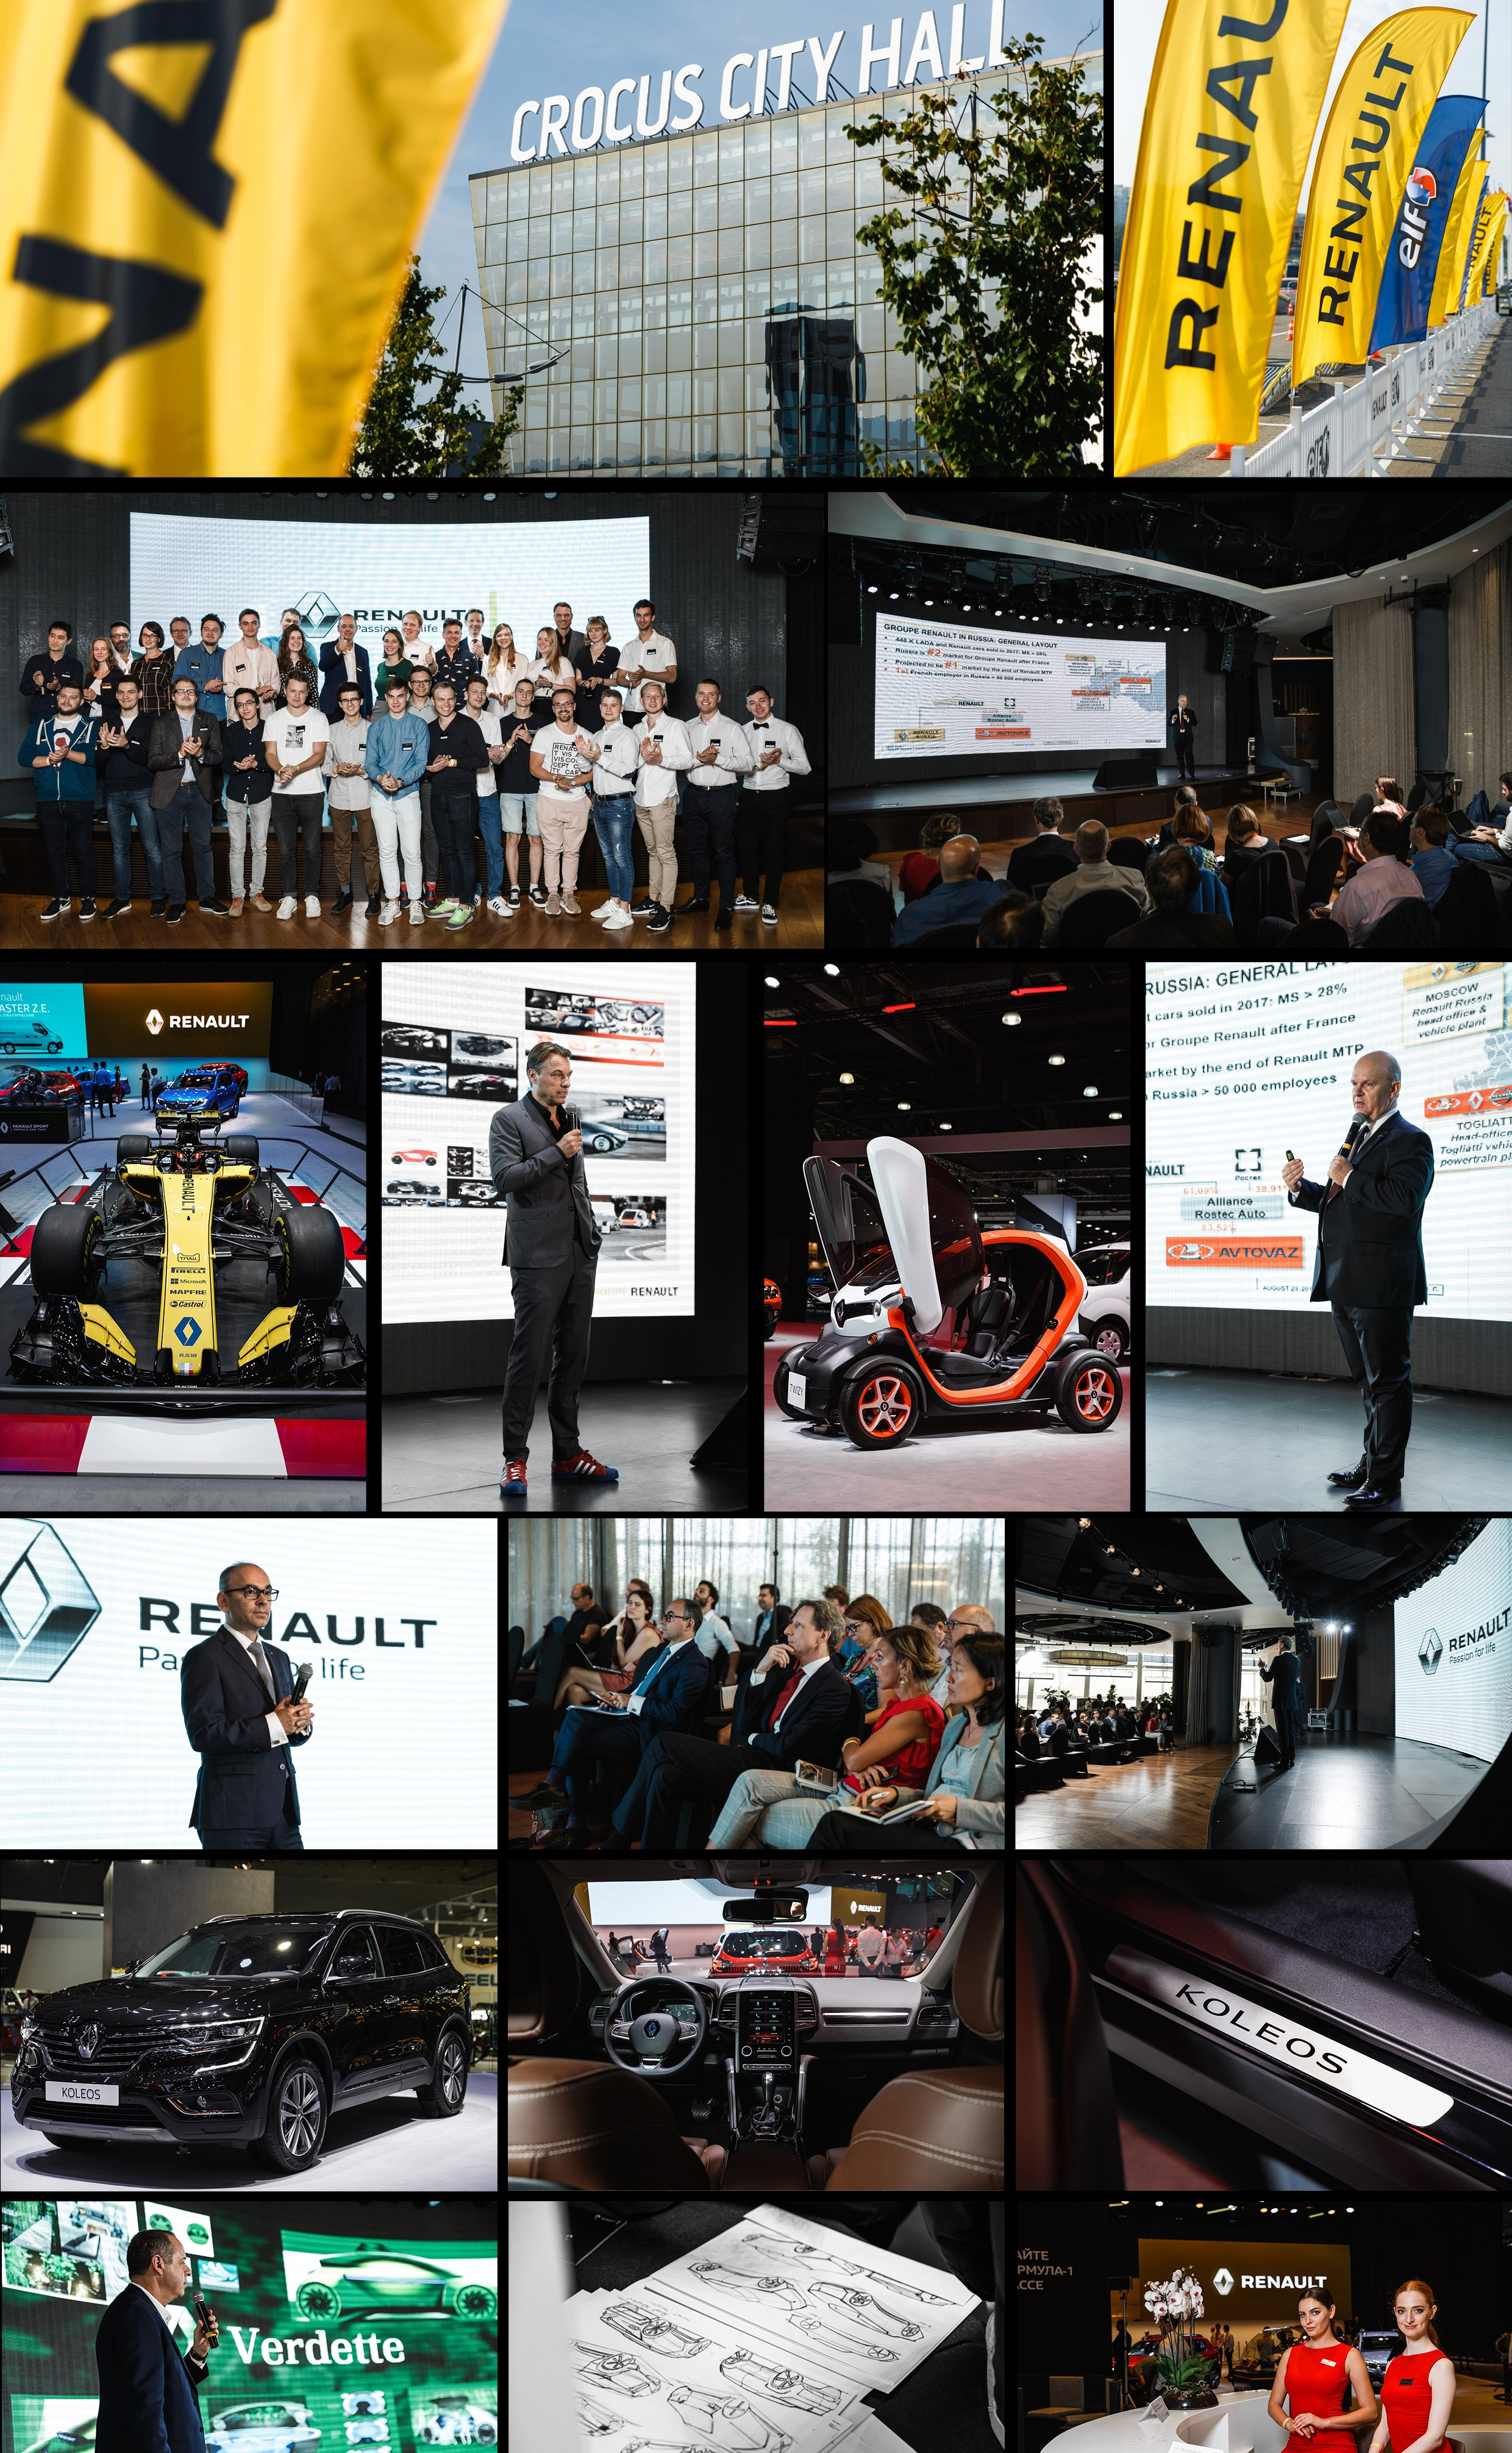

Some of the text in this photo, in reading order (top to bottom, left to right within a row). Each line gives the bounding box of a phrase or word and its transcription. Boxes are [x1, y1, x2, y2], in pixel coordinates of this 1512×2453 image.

[510, 0, 1017, 163] CROCUS CITY HALL
[1318, 42, 1415, 326] RENAULT
[1397, 202, 1430, 271] elf
[1372, 390, 1388, 421] ENAULT
[353, 610, 466, 621] RENULT
[884, 624, 919, 634] GROUPE
[922, 629, 957, 639] RENAULT
[968, 635, 996, 643] RUSSIA:
[945, 661, 958, 669] #1
[1146, 963, 1299, 996] RUSSIA: GENERAL
[1155, 1009, 1183, 1021] cars
[1188, 1004, 1216, 1018] sold
[1221, 1002, 1233, 1013] in
[1237, 996, 1274, 1012] 2017:
[1278, 991, 1299, 1005] MS
[1318, 982, 1347, 998] 28%
[1425, 982, 1479, 1002] MOSCOW
[32, 1004, 50, 1013] Z.E.
[1412, 993, 1493, 1017] Renault Russia
[169, 1014, 250, 1029] RENAULT
[1161, 1013, 1356, 1049] Groupe Renault after France
[1419, 1024, 1456, 1038] vehicle
[1182, 1064, 1197, 1077] by
[1202, 1061, 1222, 1074] the
[1226, 1057, 1251, 1071] end
[1257, 1056, 1270, 1068] of
[1274, 1050, 1328, 1066] Renault
[1332, 1043, 1364, 1058] MTP
[1153, 1075, 1338, 1101] Russia 50 000 employees
[181, 1178, 196, 1214] RENAULT
[1207, 1197, 1253, 1206] Alliance
[1194, 1209, 1266, 1219] Rostec Auto
[1219, 1247, 1299, 1259] AVTOVAZ
[631, 1287, 679, 1296] RENAULT
[790, 1383, 804, 1396] TWIZY
[1449, 1606, 1511, 1652] RENAULT
[1449, 1641, 1496, 1664] Passion for life
[321, 1657, 366, 1680] life
[858, 1904, 882, 1913] RENAULT
[1175, 1983, 1349, 2075] KOLEOS
[62, 2087, 101, 2101] KOLEOS
[1018, 2265, 1073, 2276] РМУЛА-1
[1241, 2274, 1327, 2289] RENAULT
[226, 2325, 407, 2366] Verdette
